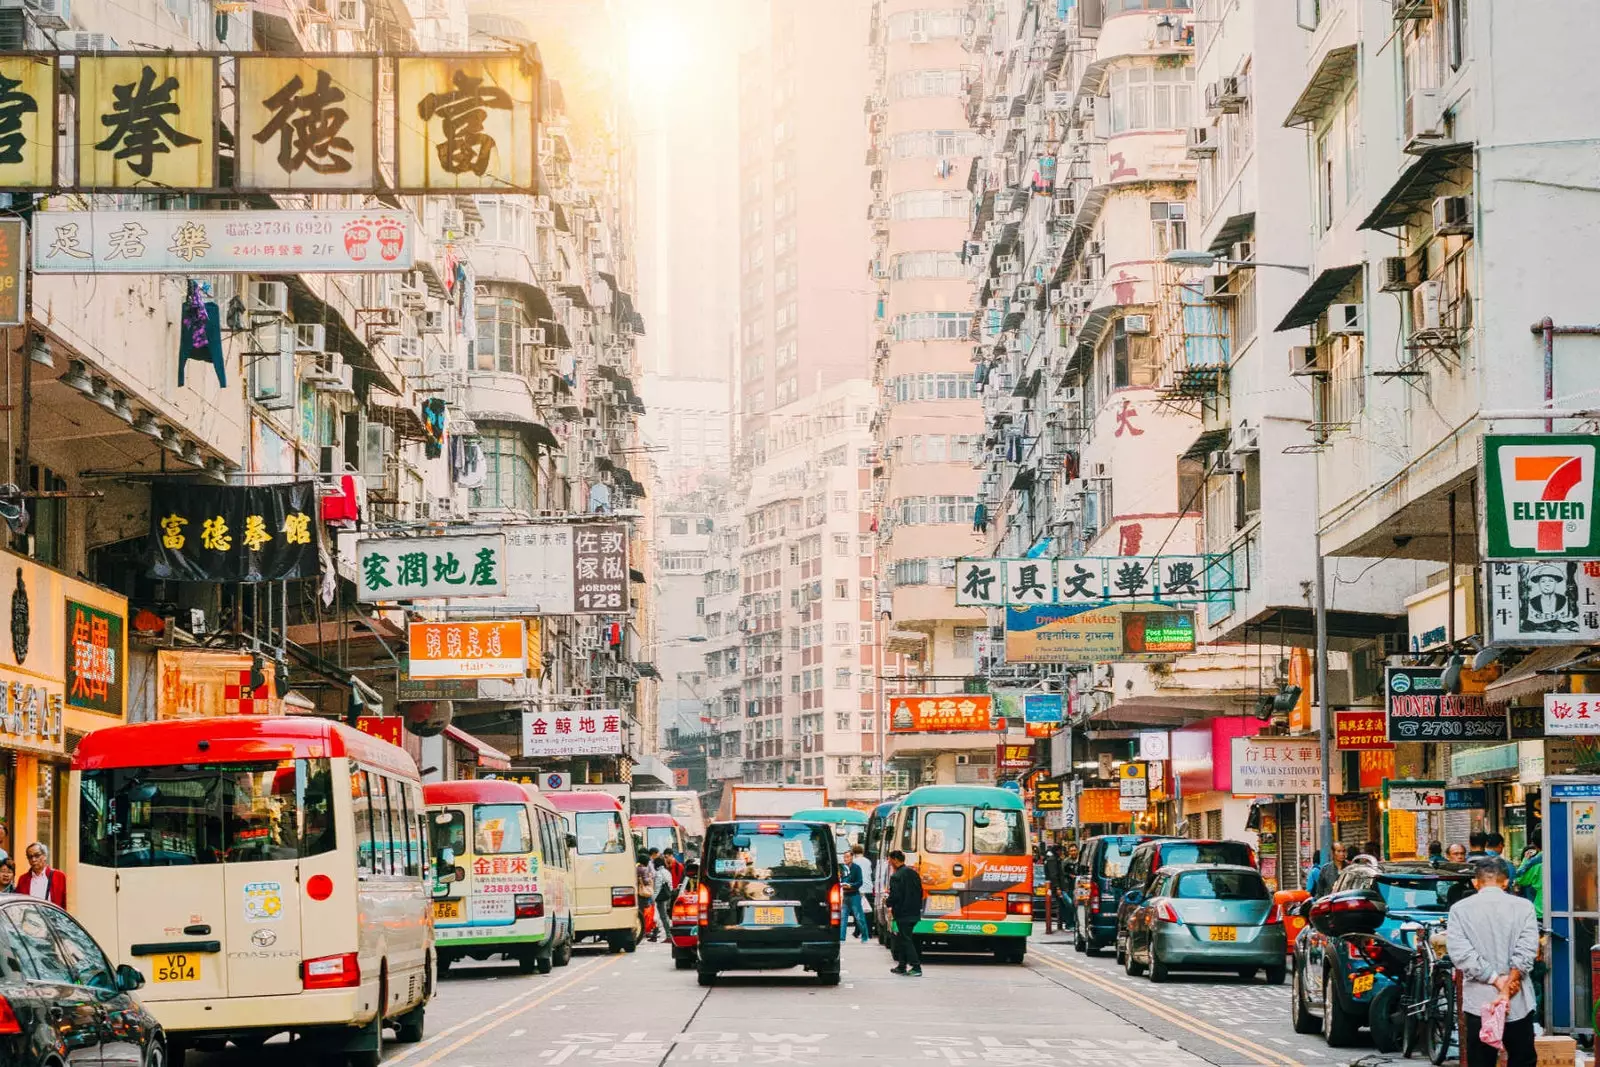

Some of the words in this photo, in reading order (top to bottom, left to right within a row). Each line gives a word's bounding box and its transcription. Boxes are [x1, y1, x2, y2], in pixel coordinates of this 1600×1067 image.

[160, 511, 312, 551] 富德拳館
[575, 530, 624, 554] 佐敦
[362, 547, 498, 591] 家潤地產
[579, 593, 622, 608] 128
[1391, 694, 1438, 717] MONEY
[532, 715, 619, 735] 金鯨地產
[1421, 721, 1463, 736] 2780
[1278, 765, 1320, 775] STATIONERY
[984, 864, 1028, 873] LALAMOVE
[167, 955, 186, 967] VD
[159, 967, 196, 980] 5614
